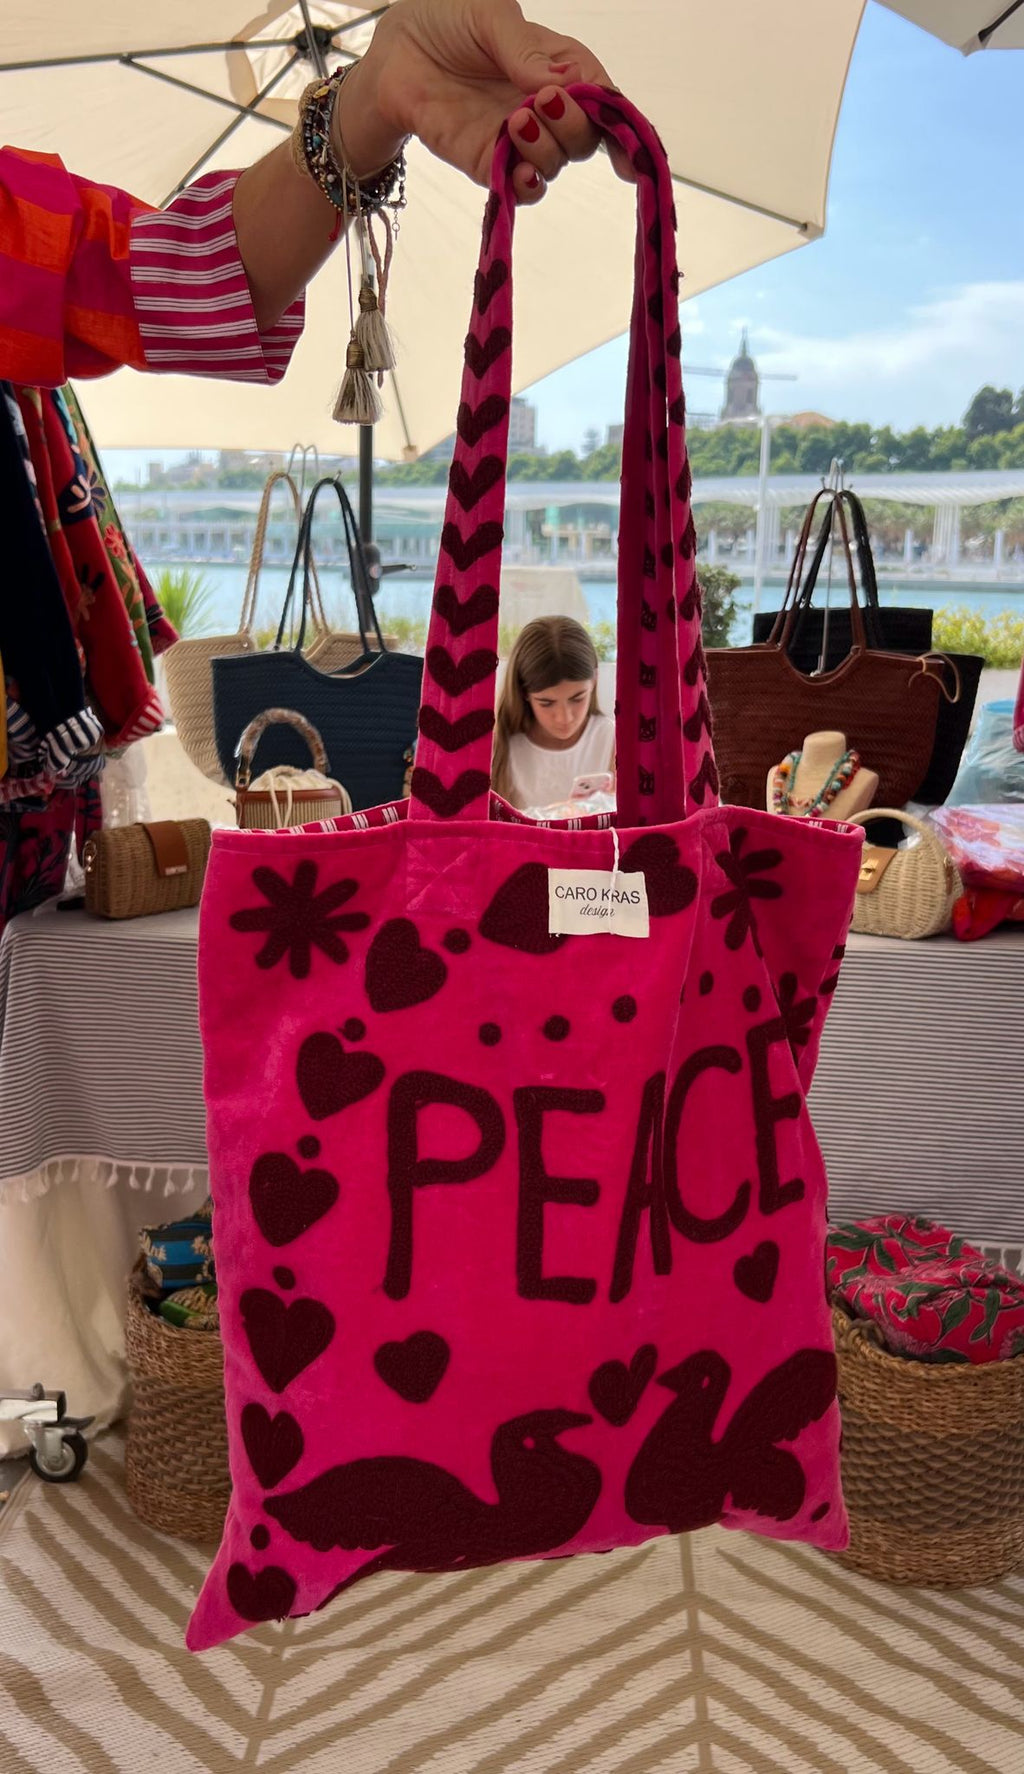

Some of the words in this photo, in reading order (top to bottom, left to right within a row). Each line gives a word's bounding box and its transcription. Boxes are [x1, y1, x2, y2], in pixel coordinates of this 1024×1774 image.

[555, 886, 597, 901] CARO
[601, 888, 641, 904] KRAS
[383, 1017, 805, 1303] PEACE
